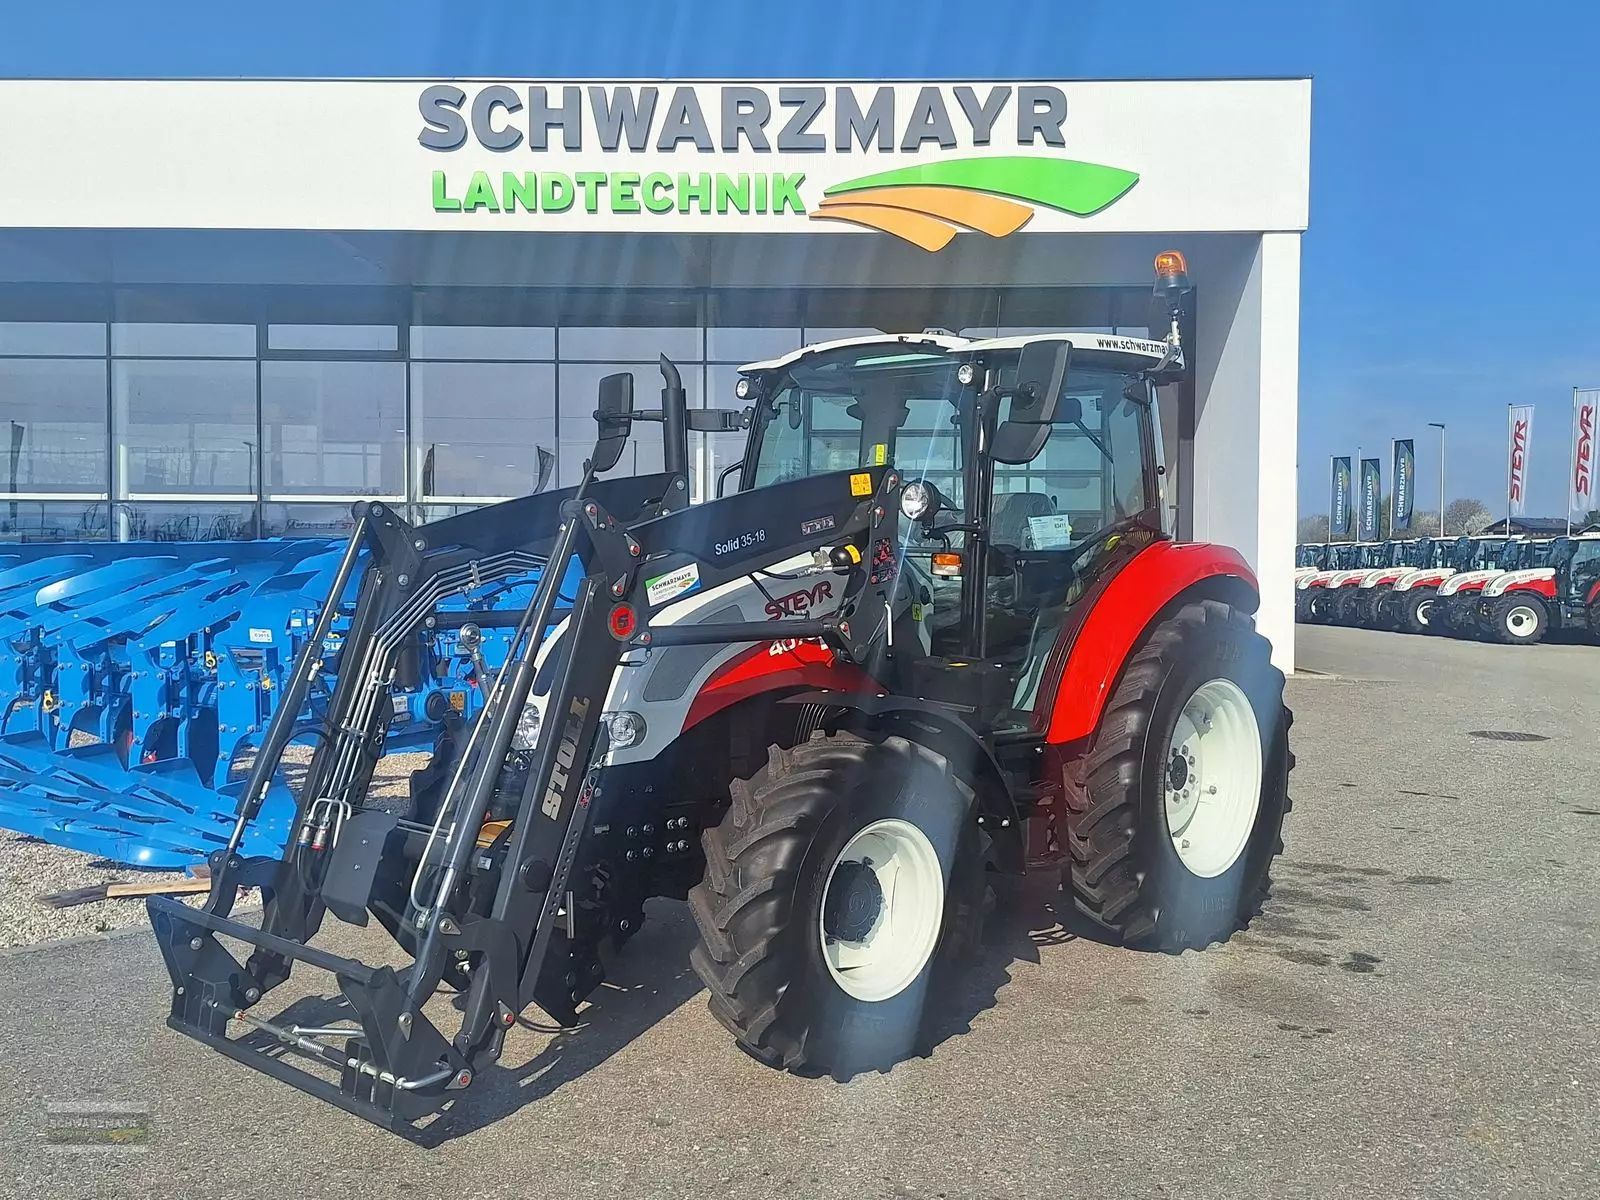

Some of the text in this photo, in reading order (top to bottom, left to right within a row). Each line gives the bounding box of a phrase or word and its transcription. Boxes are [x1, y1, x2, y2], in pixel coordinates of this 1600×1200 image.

[418, 85, 1067, 152] SCHWARZMAYR
[432, 171, 808, 214] LANDTECHNIK
[1511, 420, 1528, 502] STEYR
[1576, 405, 1593, 496] STEYR
[1365, 475, 1373, 531] SCHWARZMAYR
[1397, 457, 1405, 518] SCHWARZMAYR
[715, 529, 766, 555] Solid 35-18
[651, 572, 692, 591] SCHWARZMAYR
[764, 580, 833, 621] STEYR
[541, 696, 591, 821] STOLL
